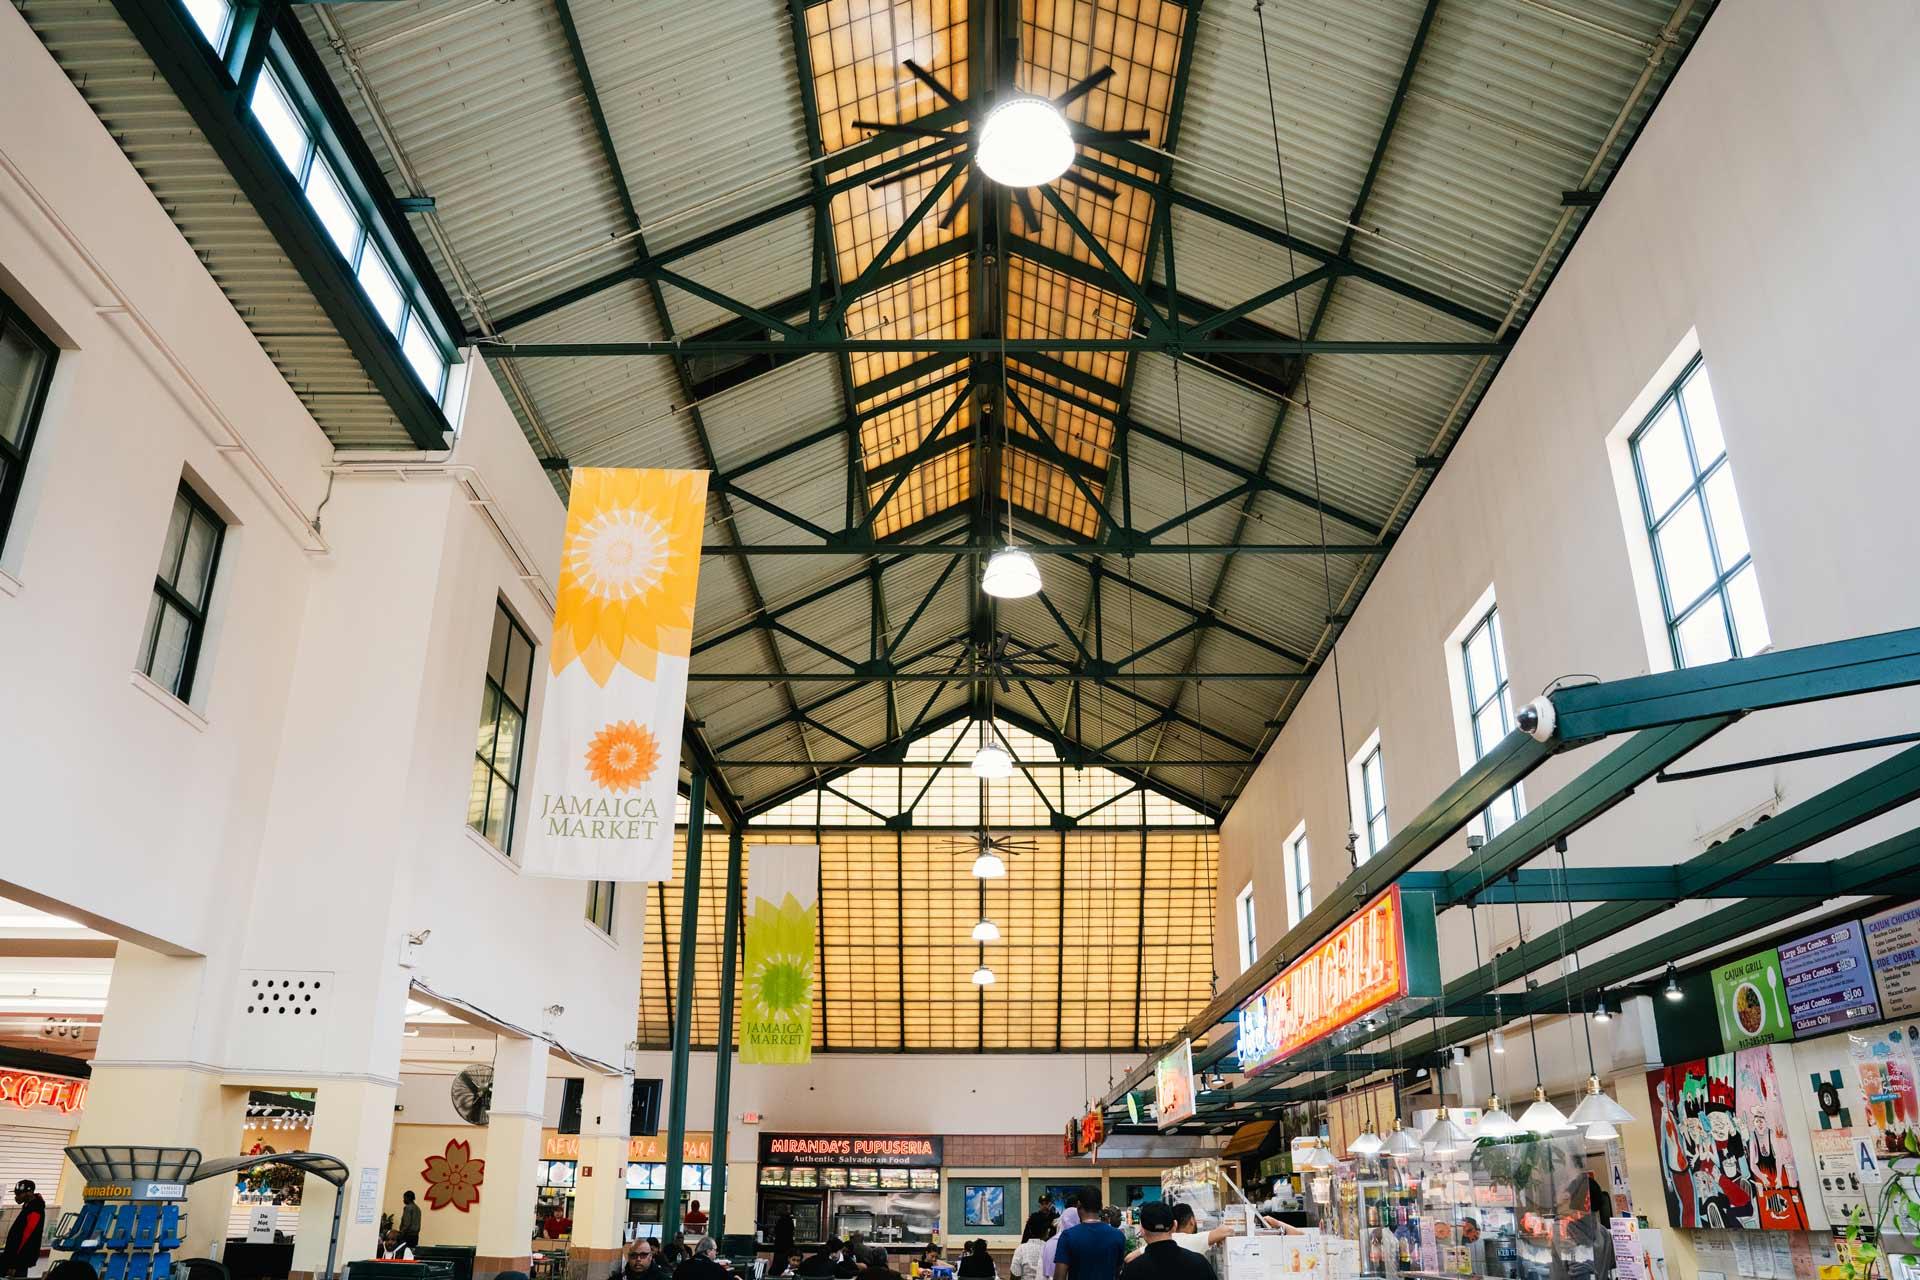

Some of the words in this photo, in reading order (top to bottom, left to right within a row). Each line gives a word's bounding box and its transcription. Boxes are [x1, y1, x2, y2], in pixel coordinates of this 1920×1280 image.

[541, 794, 659, 819] JAMAICA
[547, 817, 659, 840] MARKET
[1869, 919, 1889, 932] CAJUN
[1783, 949, 1796, 959] Large
[1797, 945, 1807, 954] Size
[1808, 939, 1828, 950] Combo:
[1322, 907, 1388, 1014] GRILL
[1877, 957, 1890, 968] SIDE
[1893, 950, 1917, 962] ORDER
[1725, 966, 1744, 980] CAJUN
[1746, 960, 1763, 974] GRILL
[1788, 974, 1802, 985] Small
[1802, 971, 1812, 981] Size
[1812, 966, 1834, 978] Combo:
[1793, 1002, 1810, 1013] Special
[1811, 998, 1832, 1008] Combo:
[747, 1023, 804, 1034] JAMAICA
[1796, 1018, 1817, 1030] Chicken
[1817, 1015, 1831, 1025] Only
[751, 1034, 804, 1045] MARKET
[771, 1139, 850, 1154] MIRANDA'S
[854, 1140, 932, 1155] PUPUSERIA
[1860, 1141, 1875, 1170] A
[793, 1155, 835, 1163] Authentic
[838, 1155, 887, 1164] Salvadoran
[888, 1156, 911, 1165] Food
[1614, 1165, 1622, 1185] A
